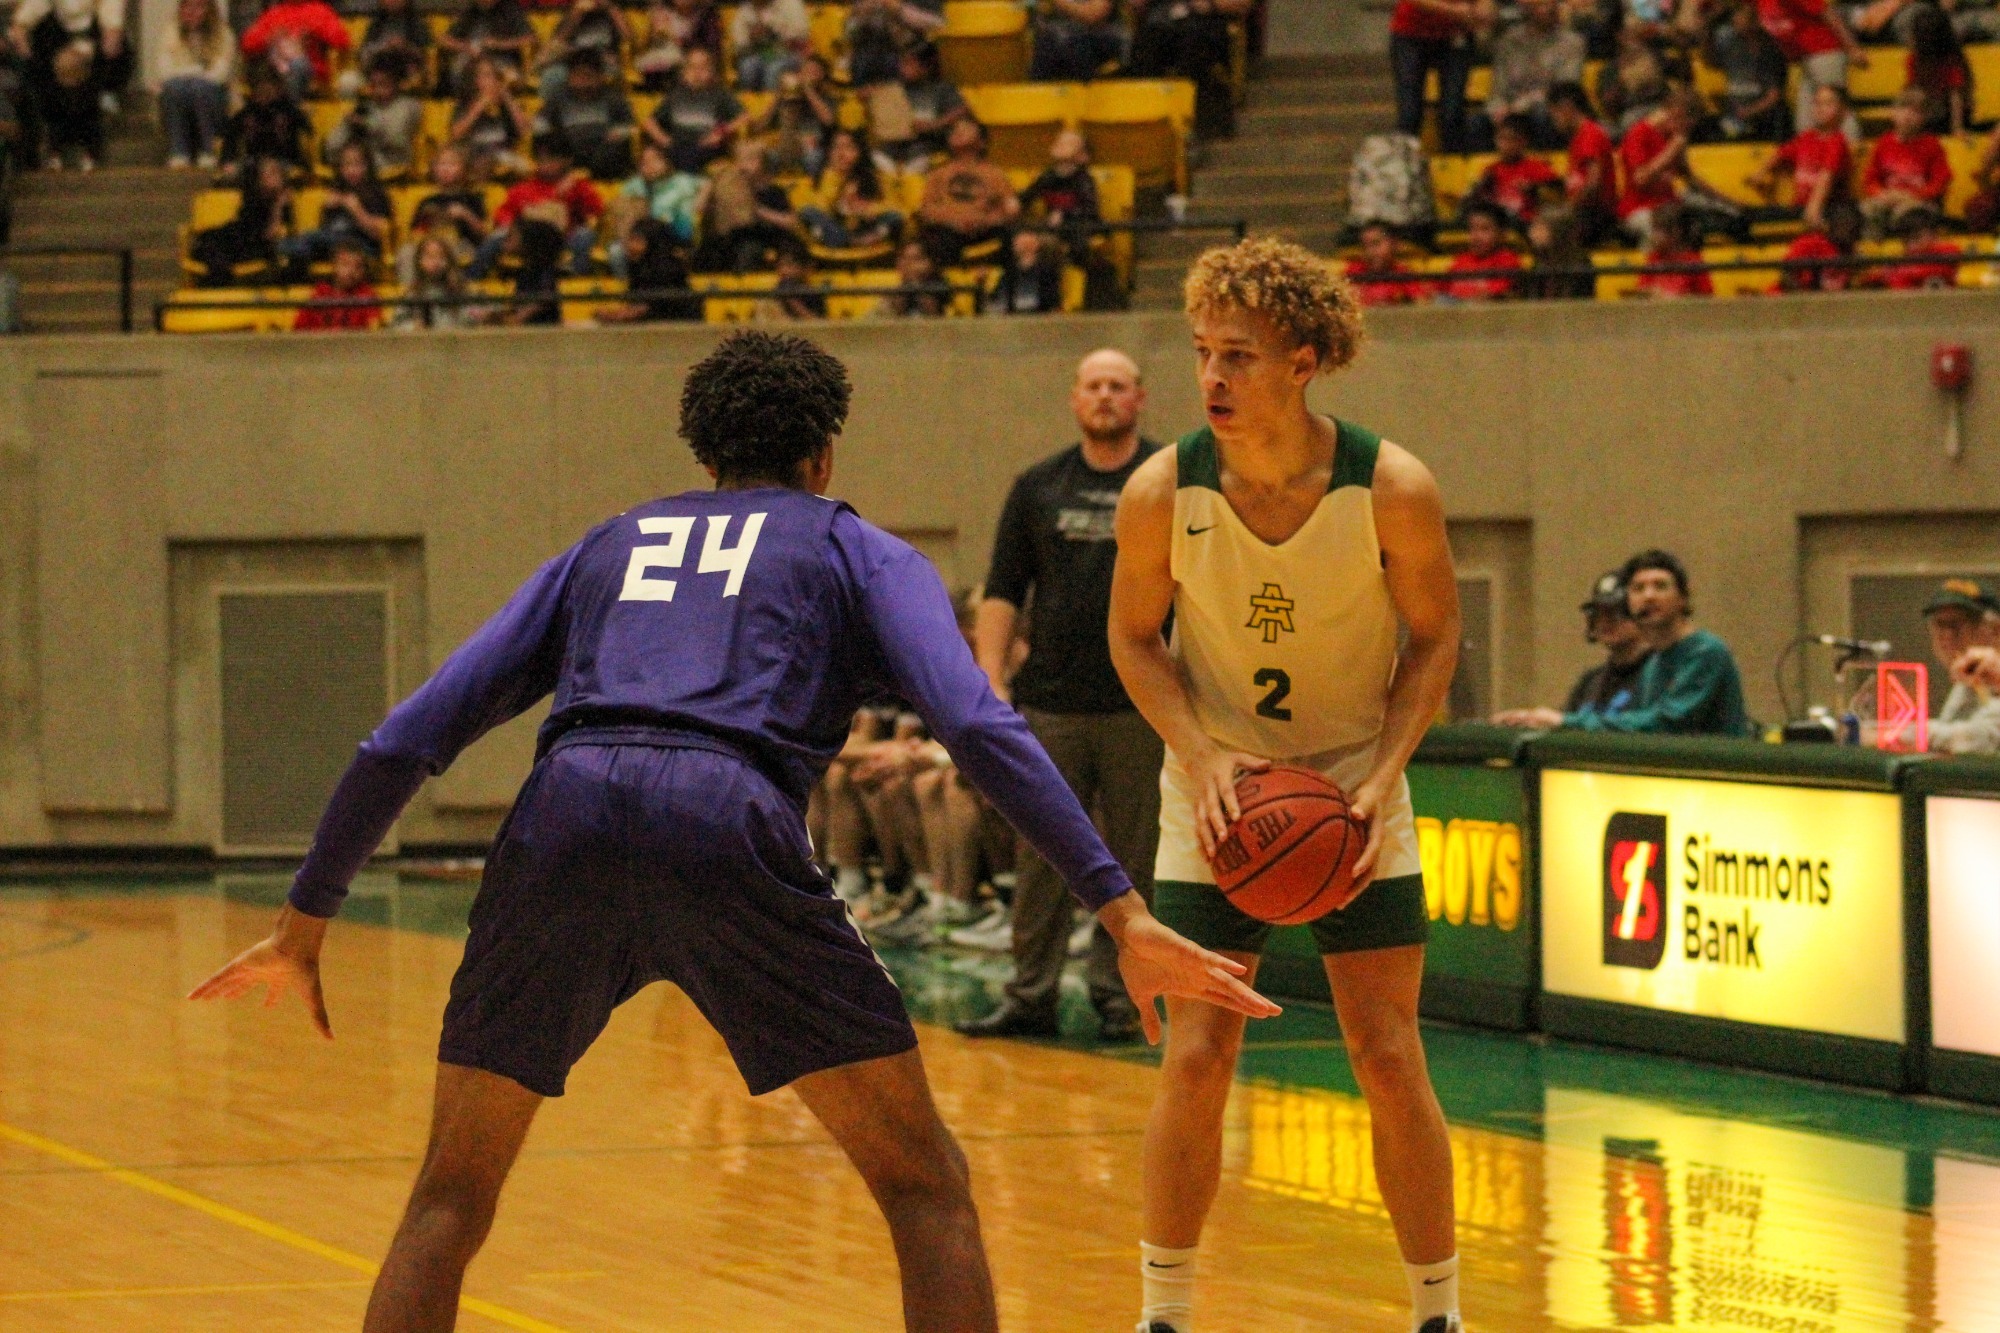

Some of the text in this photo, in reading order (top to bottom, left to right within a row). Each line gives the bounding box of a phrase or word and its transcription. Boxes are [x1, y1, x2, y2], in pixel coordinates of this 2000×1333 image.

[618, 512, 768, 602] 24
[1253, 667, 1292, 721] 2
[1415, 817, 1521, 931] BOYS
[1685, 833, 1830, 905] Simmons
[1685, 905, 1760, 968] Bank
